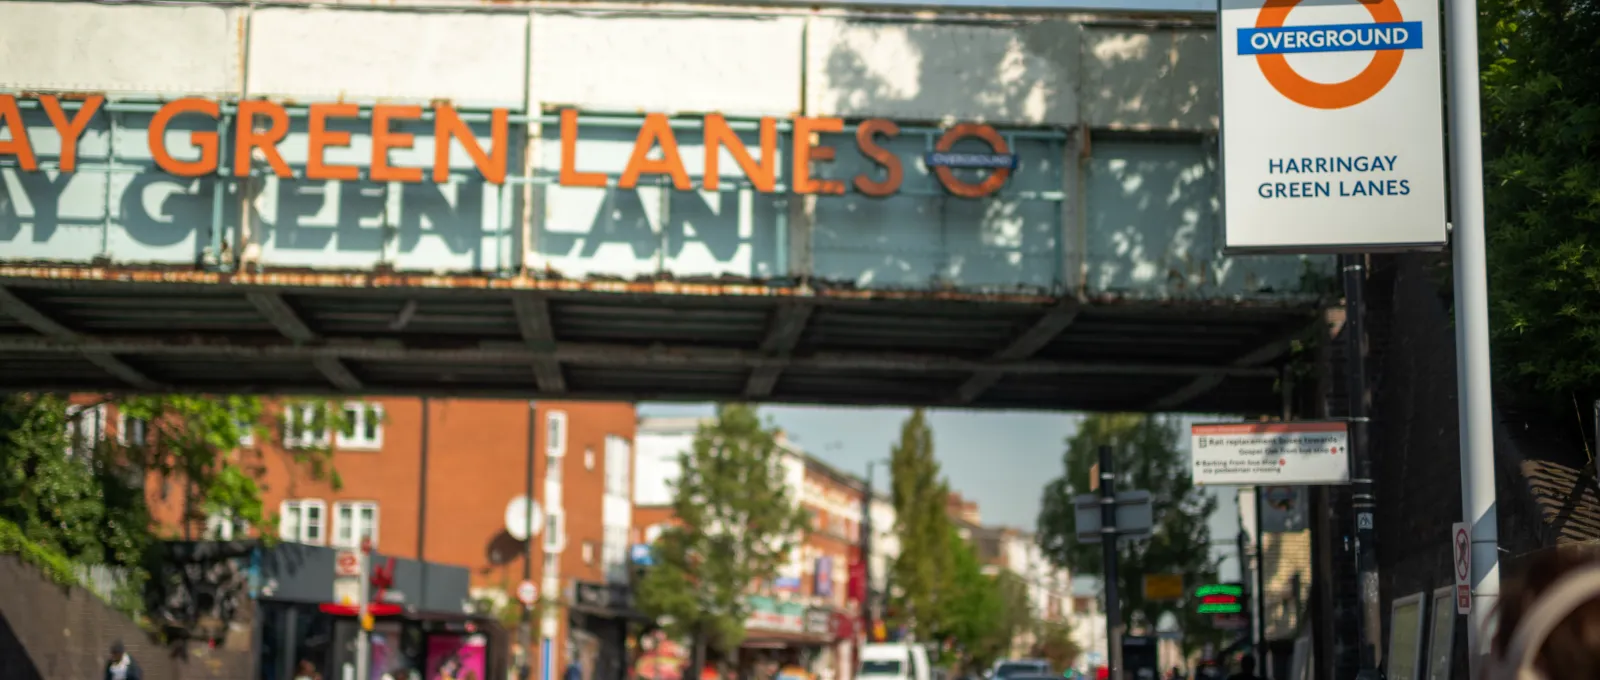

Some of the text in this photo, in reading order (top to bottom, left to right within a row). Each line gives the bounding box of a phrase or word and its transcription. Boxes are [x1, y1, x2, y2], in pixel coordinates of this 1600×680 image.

[1251, 27, 1409, 49] OVERGROUND
[147, 97, 509, 184] GREEN
[559, 108, 903, 197] LANES
[1268, 155, 1398, 174] HARRINGAY
[1258, 179, 1411, 199] GREEN LANES
[1304, 436, 1338, 444] towards
